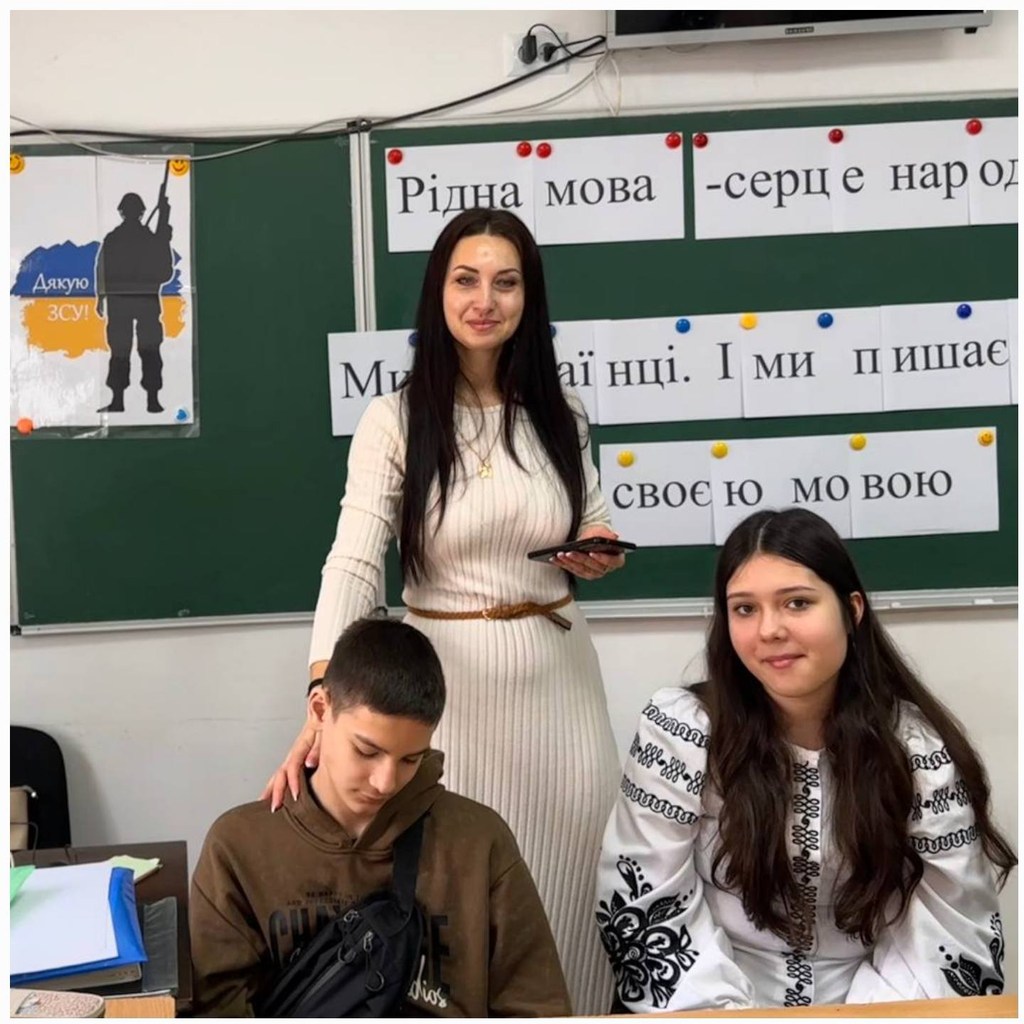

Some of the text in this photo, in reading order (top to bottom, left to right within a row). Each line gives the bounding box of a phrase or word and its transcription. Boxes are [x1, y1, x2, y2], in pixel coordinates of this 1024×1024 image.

[396, 173, 656, 218] Рідна мова
[32, 272, 90, 296] Дякую
[47, 303, 90, 321] ЗСУ!
[752, 351, 815, 380] ми
[612, 470, 953, 509] своєю мовою
